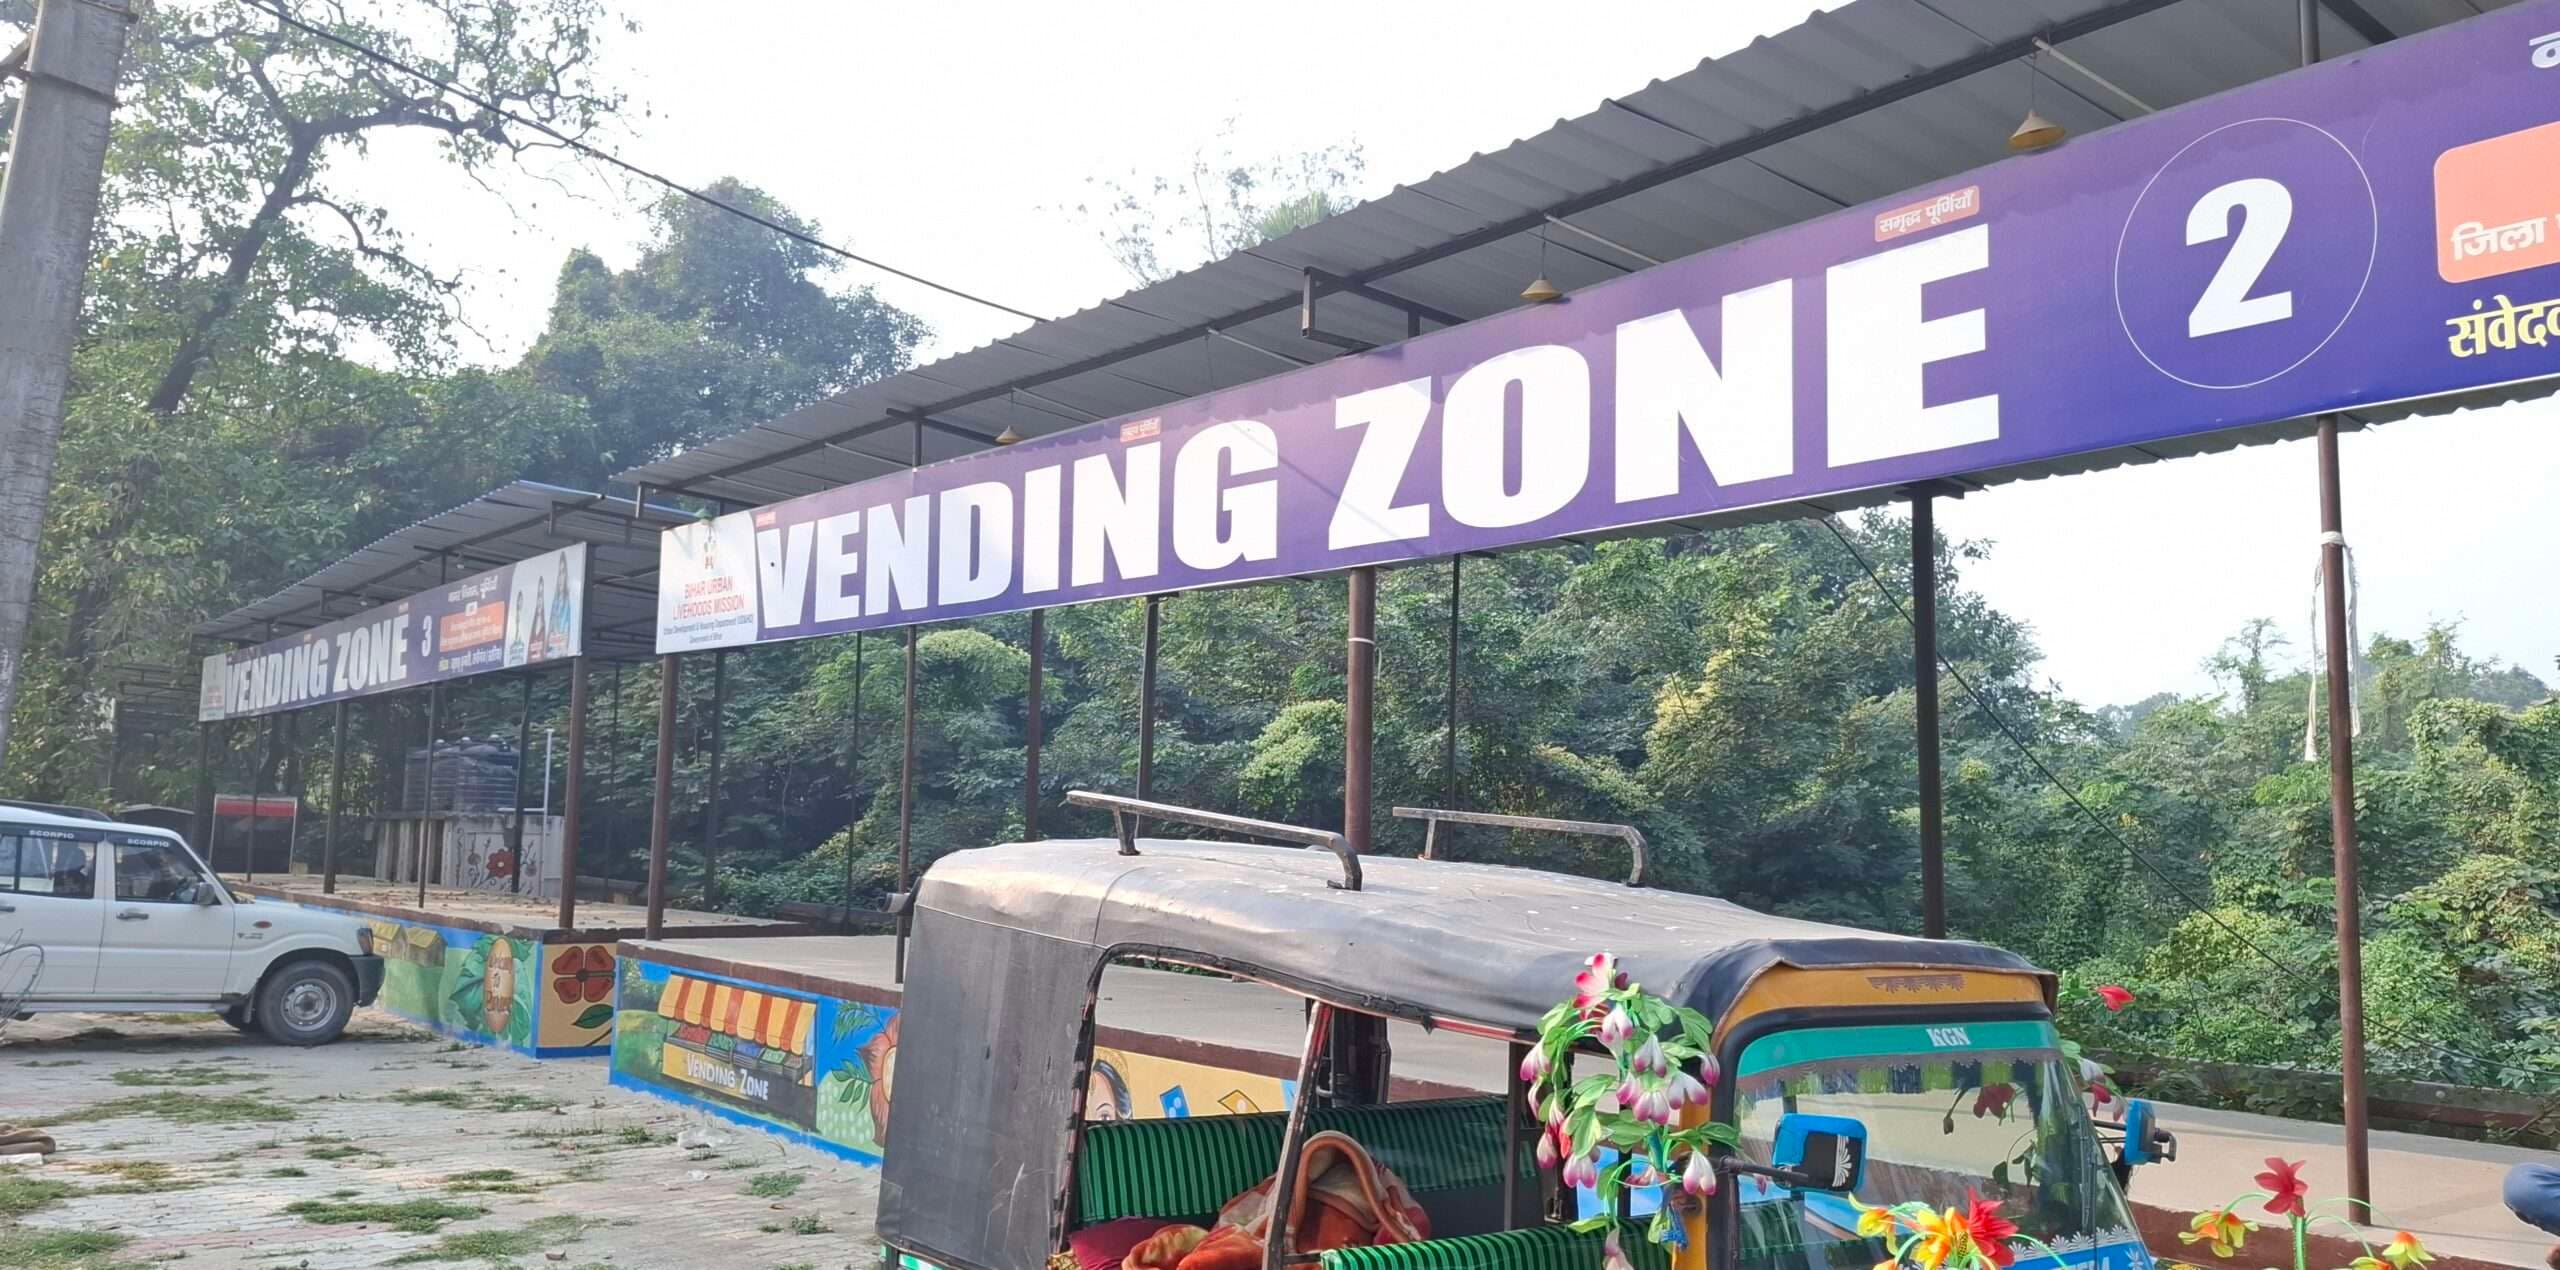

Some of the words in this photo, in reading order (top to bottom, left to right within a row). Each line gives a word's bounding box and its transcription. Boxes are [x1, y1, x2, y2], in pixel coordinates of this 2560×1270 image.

[2450, 216, 2547, 262] जिला
[757, 420, 1279, 628] VENDING
[1329, 223, 1999, 550] ZONE
[2186, 178, 2293, 338] 2
[226, 639, 328, 714] VENDING
[333, 613, 409, 693] ZONE
[421, 615, 432, 657] 3
[29, 829, 75, 839] SCORPIO
[127, 838, 170, 848] SCORPIO
[1926, 1026, 1972, 1048] KGN
[687, 1053, 736, 1089] VENDING
[740, 1068, 769, 1101] ZONE
